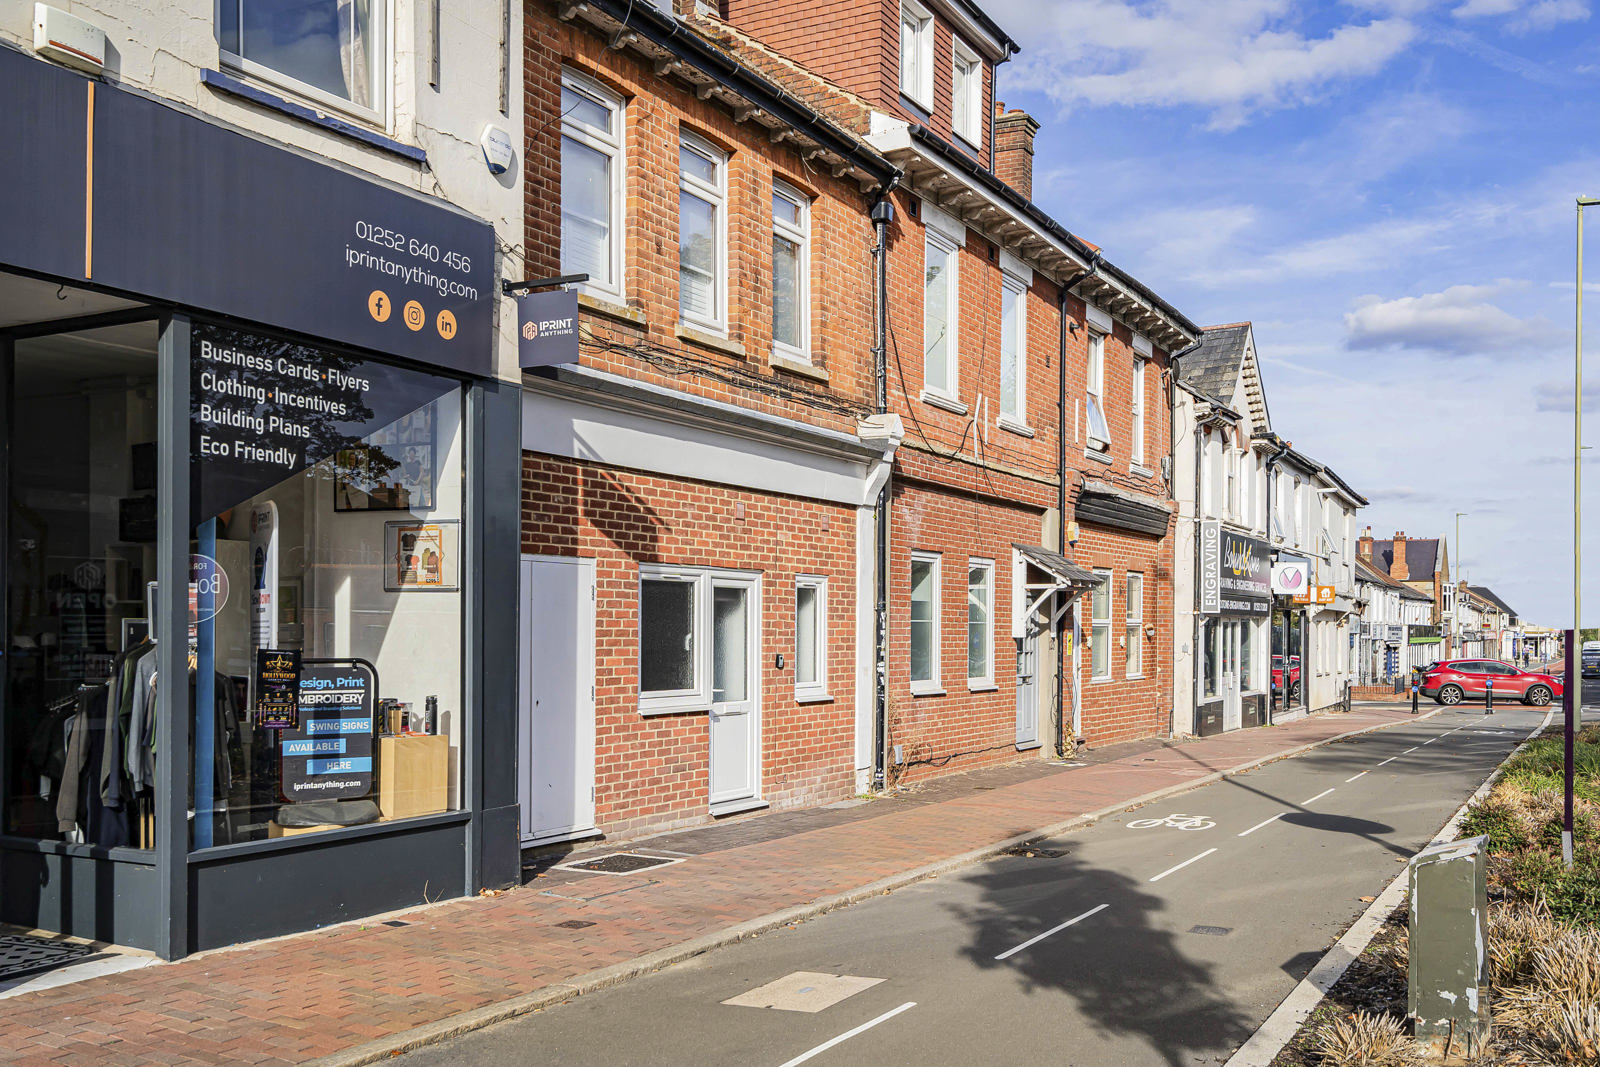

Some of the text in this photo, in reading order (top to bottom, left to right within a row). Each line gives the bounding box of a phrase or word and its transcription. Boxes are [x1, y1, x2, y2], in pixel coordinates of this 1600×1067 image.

[355, 220, 471, 273] 01252 640 456
[345, 243, 478, 301] iprintanything.com
[539, 318, 573, 331] IPRINT
[540, 329, 573, 337] ANYTHING
[201, 340, 370, 392] Business Cards Flyers
[201, 372, 347, 415] Clothing Incentives
[200, 403, 310, 438] Building Plans
[200, 435, 297, 470] Eco Friendly
[1205, 528, 1217, 606] ENGRAVING
[299, 677, 335, 690] esign,
[336, 676, 365, 688] Print
[298, 693, 365, 704] MBROIDERY
[309, 721, 369, 732] SWING SIGNS
[288, 742, 340, 753] AVAILABLE
[326, 761, 352, 771] HERE
[293, 780, 361, 792] iprintanything.com
